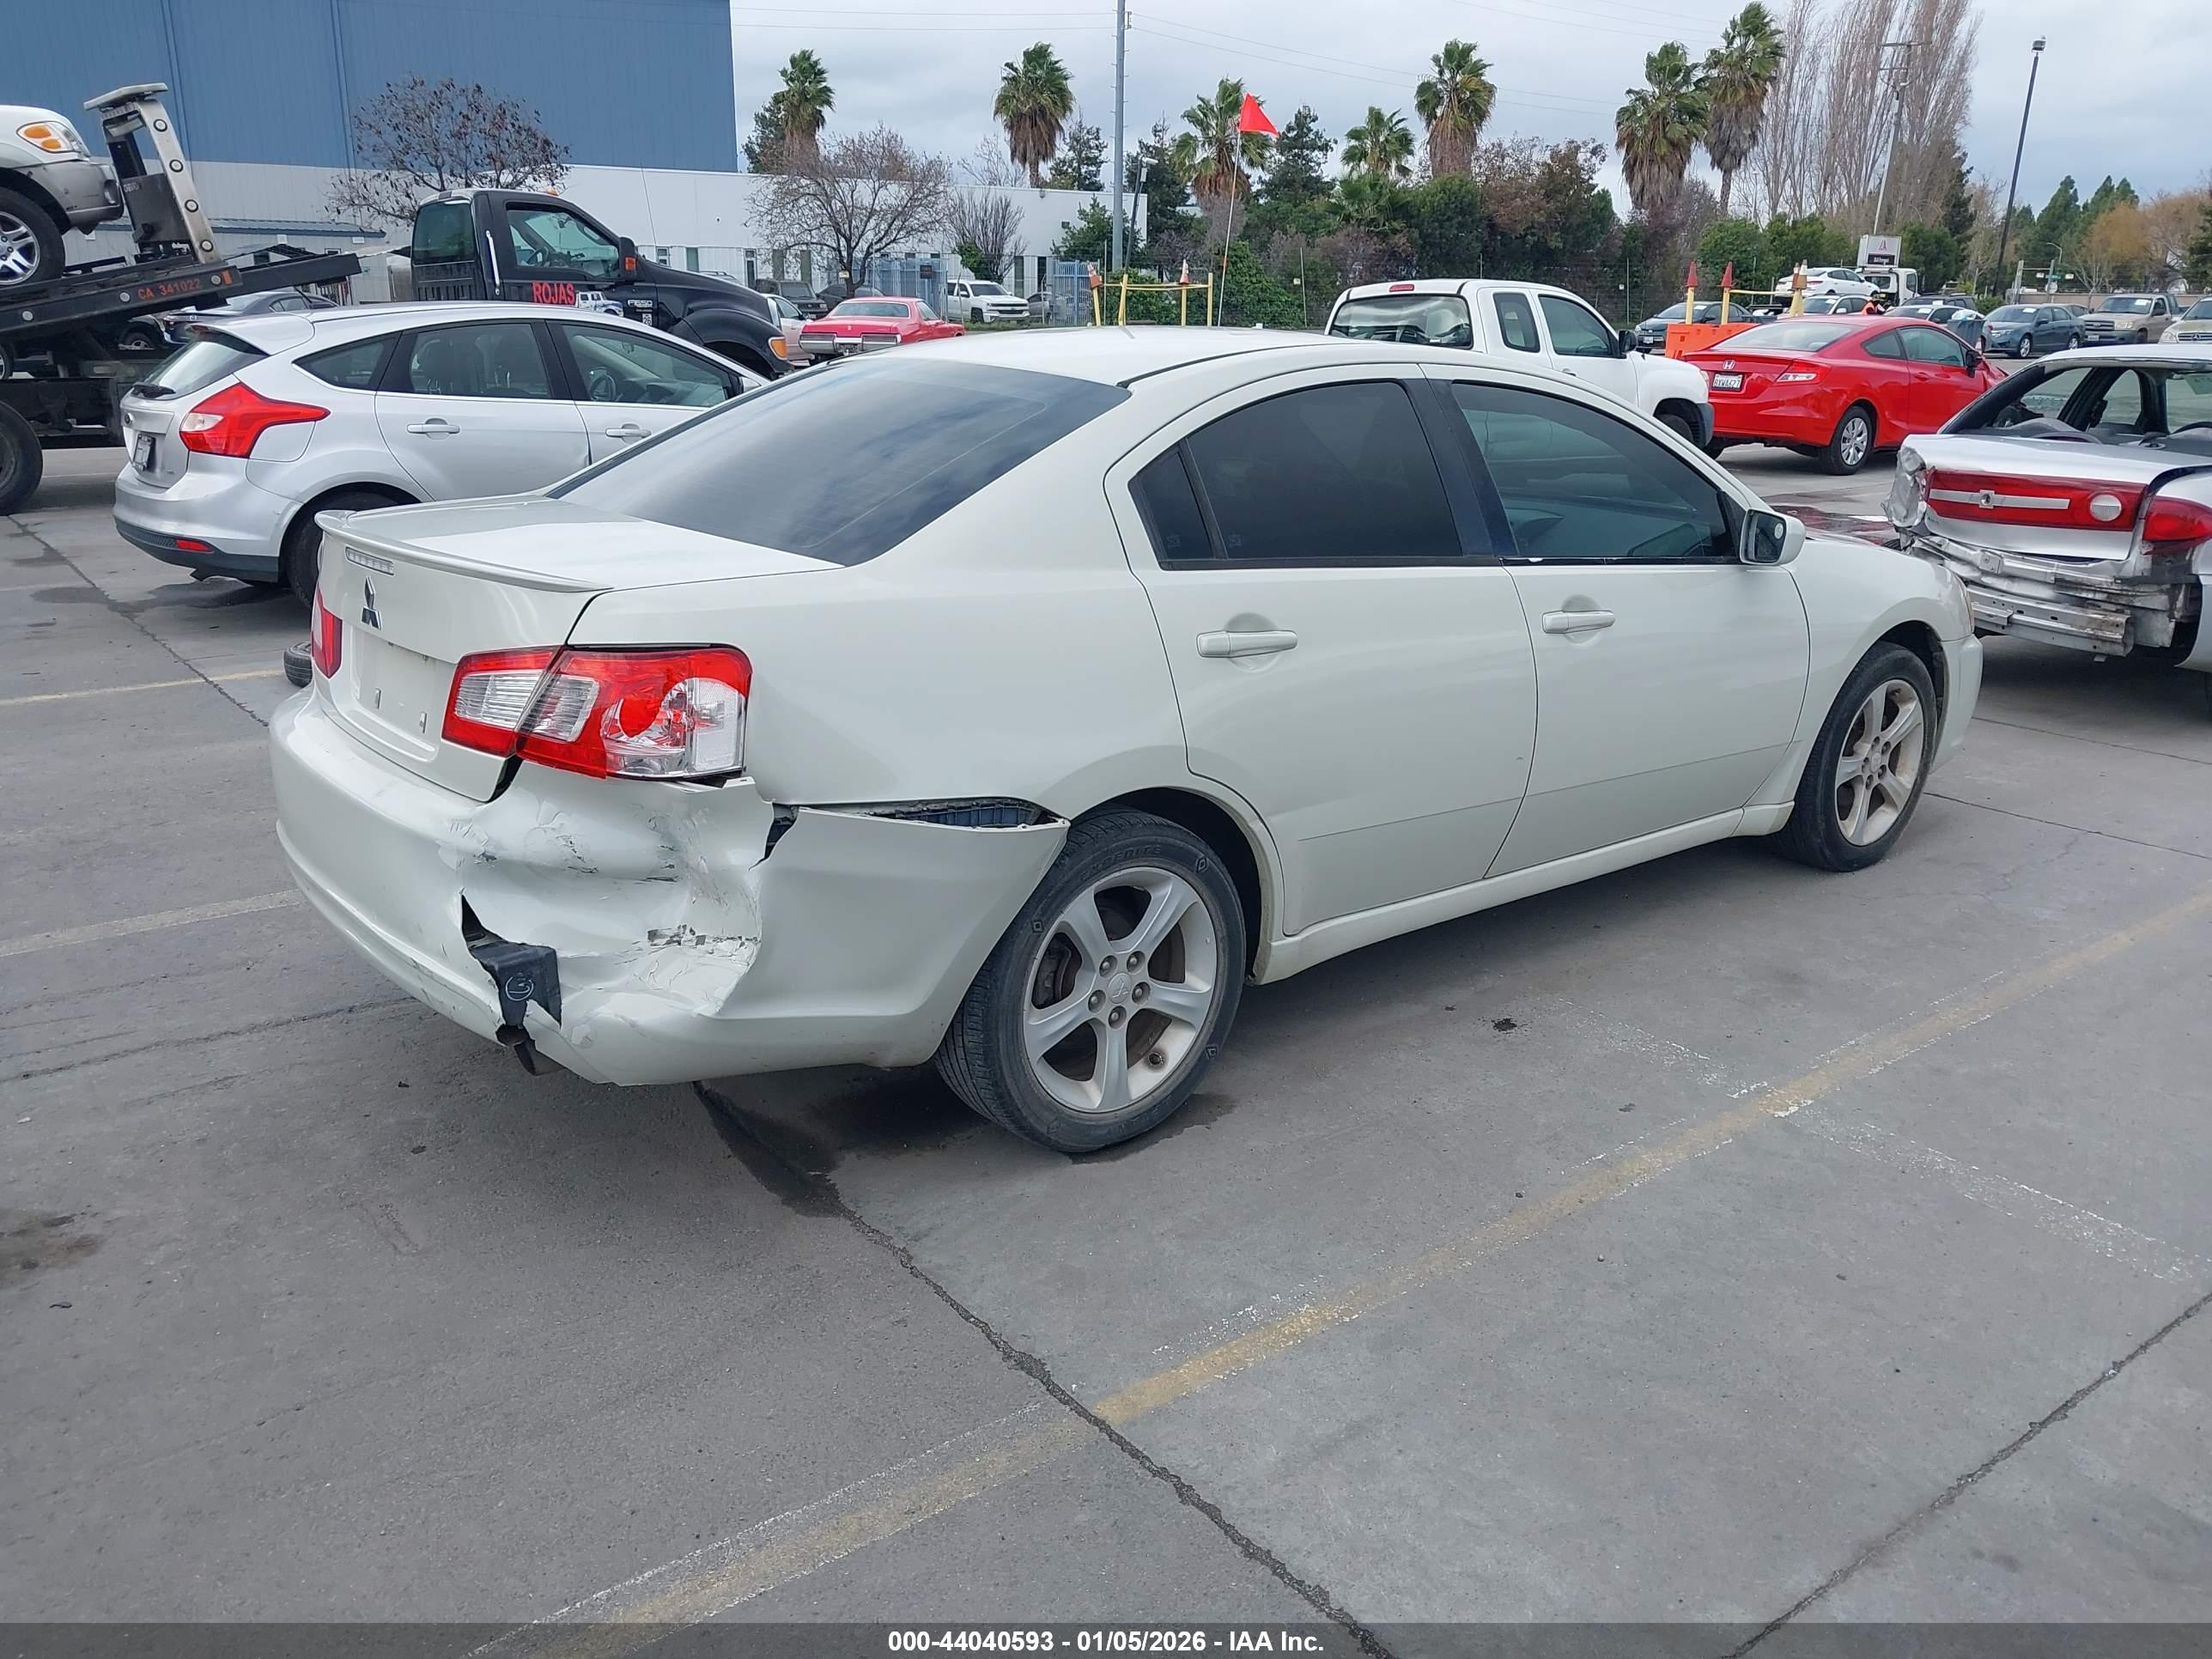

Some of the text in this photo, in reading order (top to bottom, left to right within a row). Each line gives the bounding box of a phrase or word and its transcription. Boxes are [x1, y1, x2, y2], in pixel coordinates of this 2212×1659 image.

[137, 278, 203, 300] CA 341022
[532, 281, 575, 305] ROJAS
